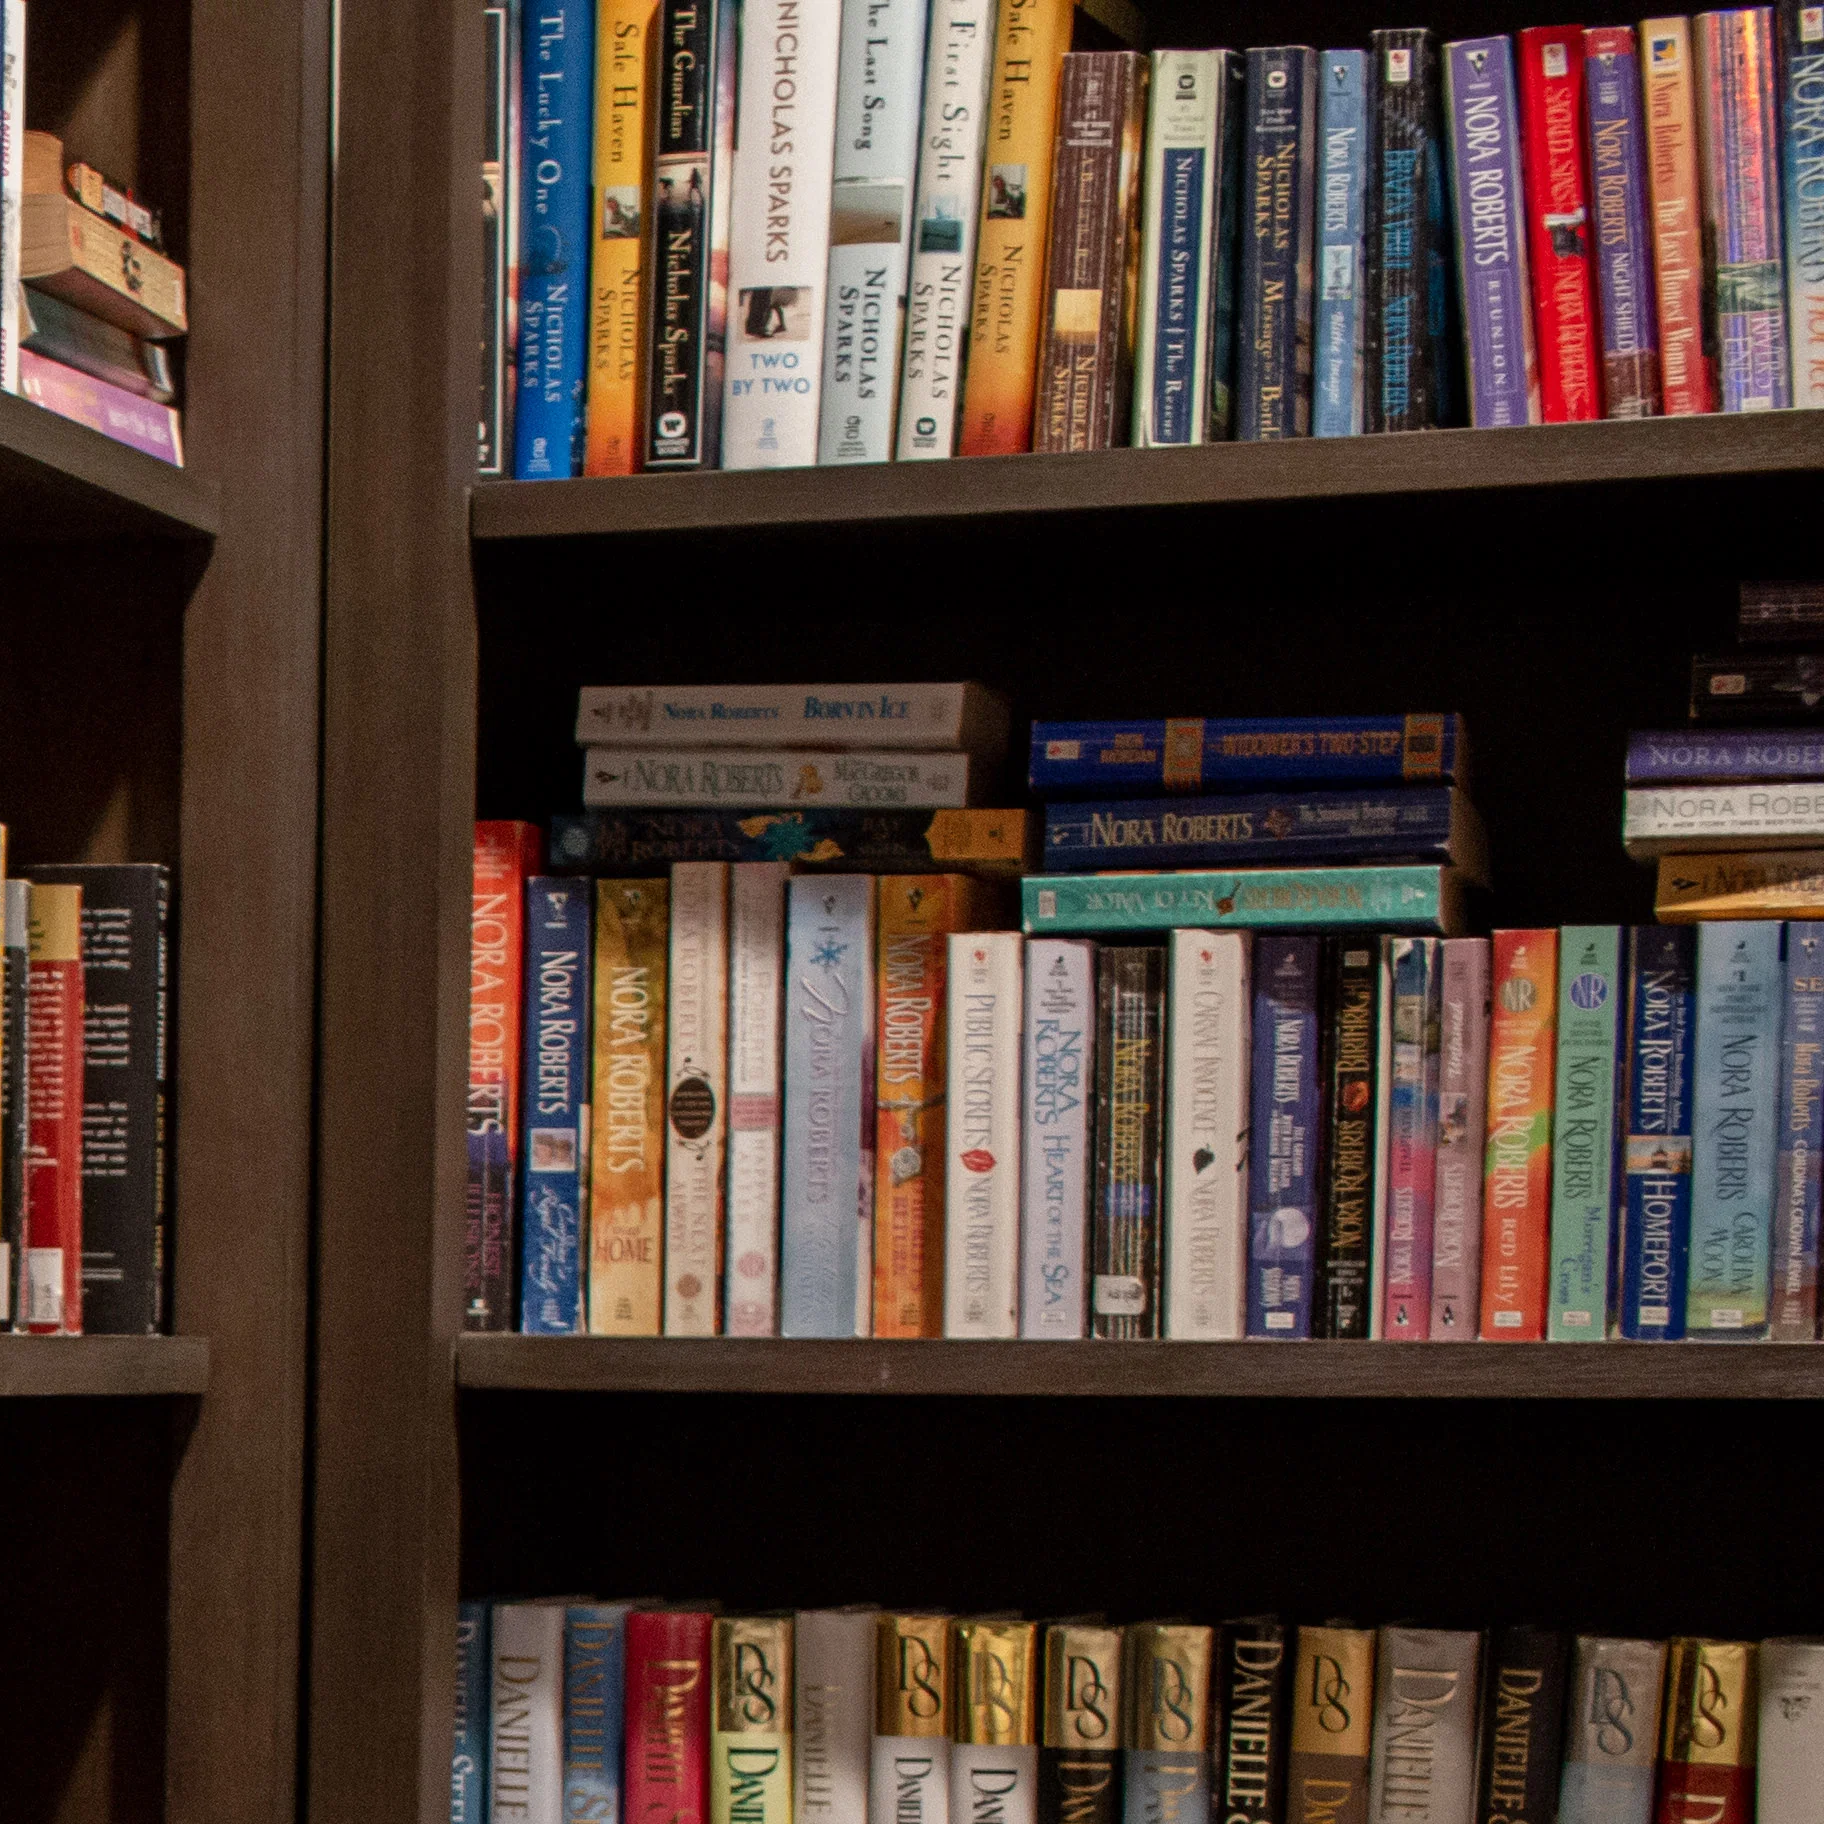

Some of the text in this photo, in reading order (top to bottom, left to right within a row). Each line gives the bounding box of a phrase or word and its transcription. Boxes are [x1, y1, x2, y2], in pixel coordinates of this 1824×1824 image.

[533, 10, 564, 215] The Lucky One
[669, 6, 698, 139] The Guardian
[765, 2, 799, 262] NICHOLAS SPARKS
[660, 231, 693, 395] Nicholas Sparks
[1463, 95, 1508, 385] NORA ROBERTS REUNION
[732, 353, 811, 395] TWO BY TWO
[834, 268, 887, 399] NICHOLAS SPARKS
[538, 950, 578, 1114] NORA ROBERTS
[607, 965, 651, 1173] NORA ROBERTS
[884, 934, 927, 1084] NORA ROBERTS
[1493, 1045, 1535, 1209] NORA ROBERTS
[1640, 971, 1677, 1302] NORA ROBERTS HOMEPORT
[1703, 1035, 1759, 1296] NORA ROBERTS CAROLINA MOON
[1385, 1667, 1459, 1821] DANIELLE
[1489, 1669, 1543, 1809] DANIELLE
